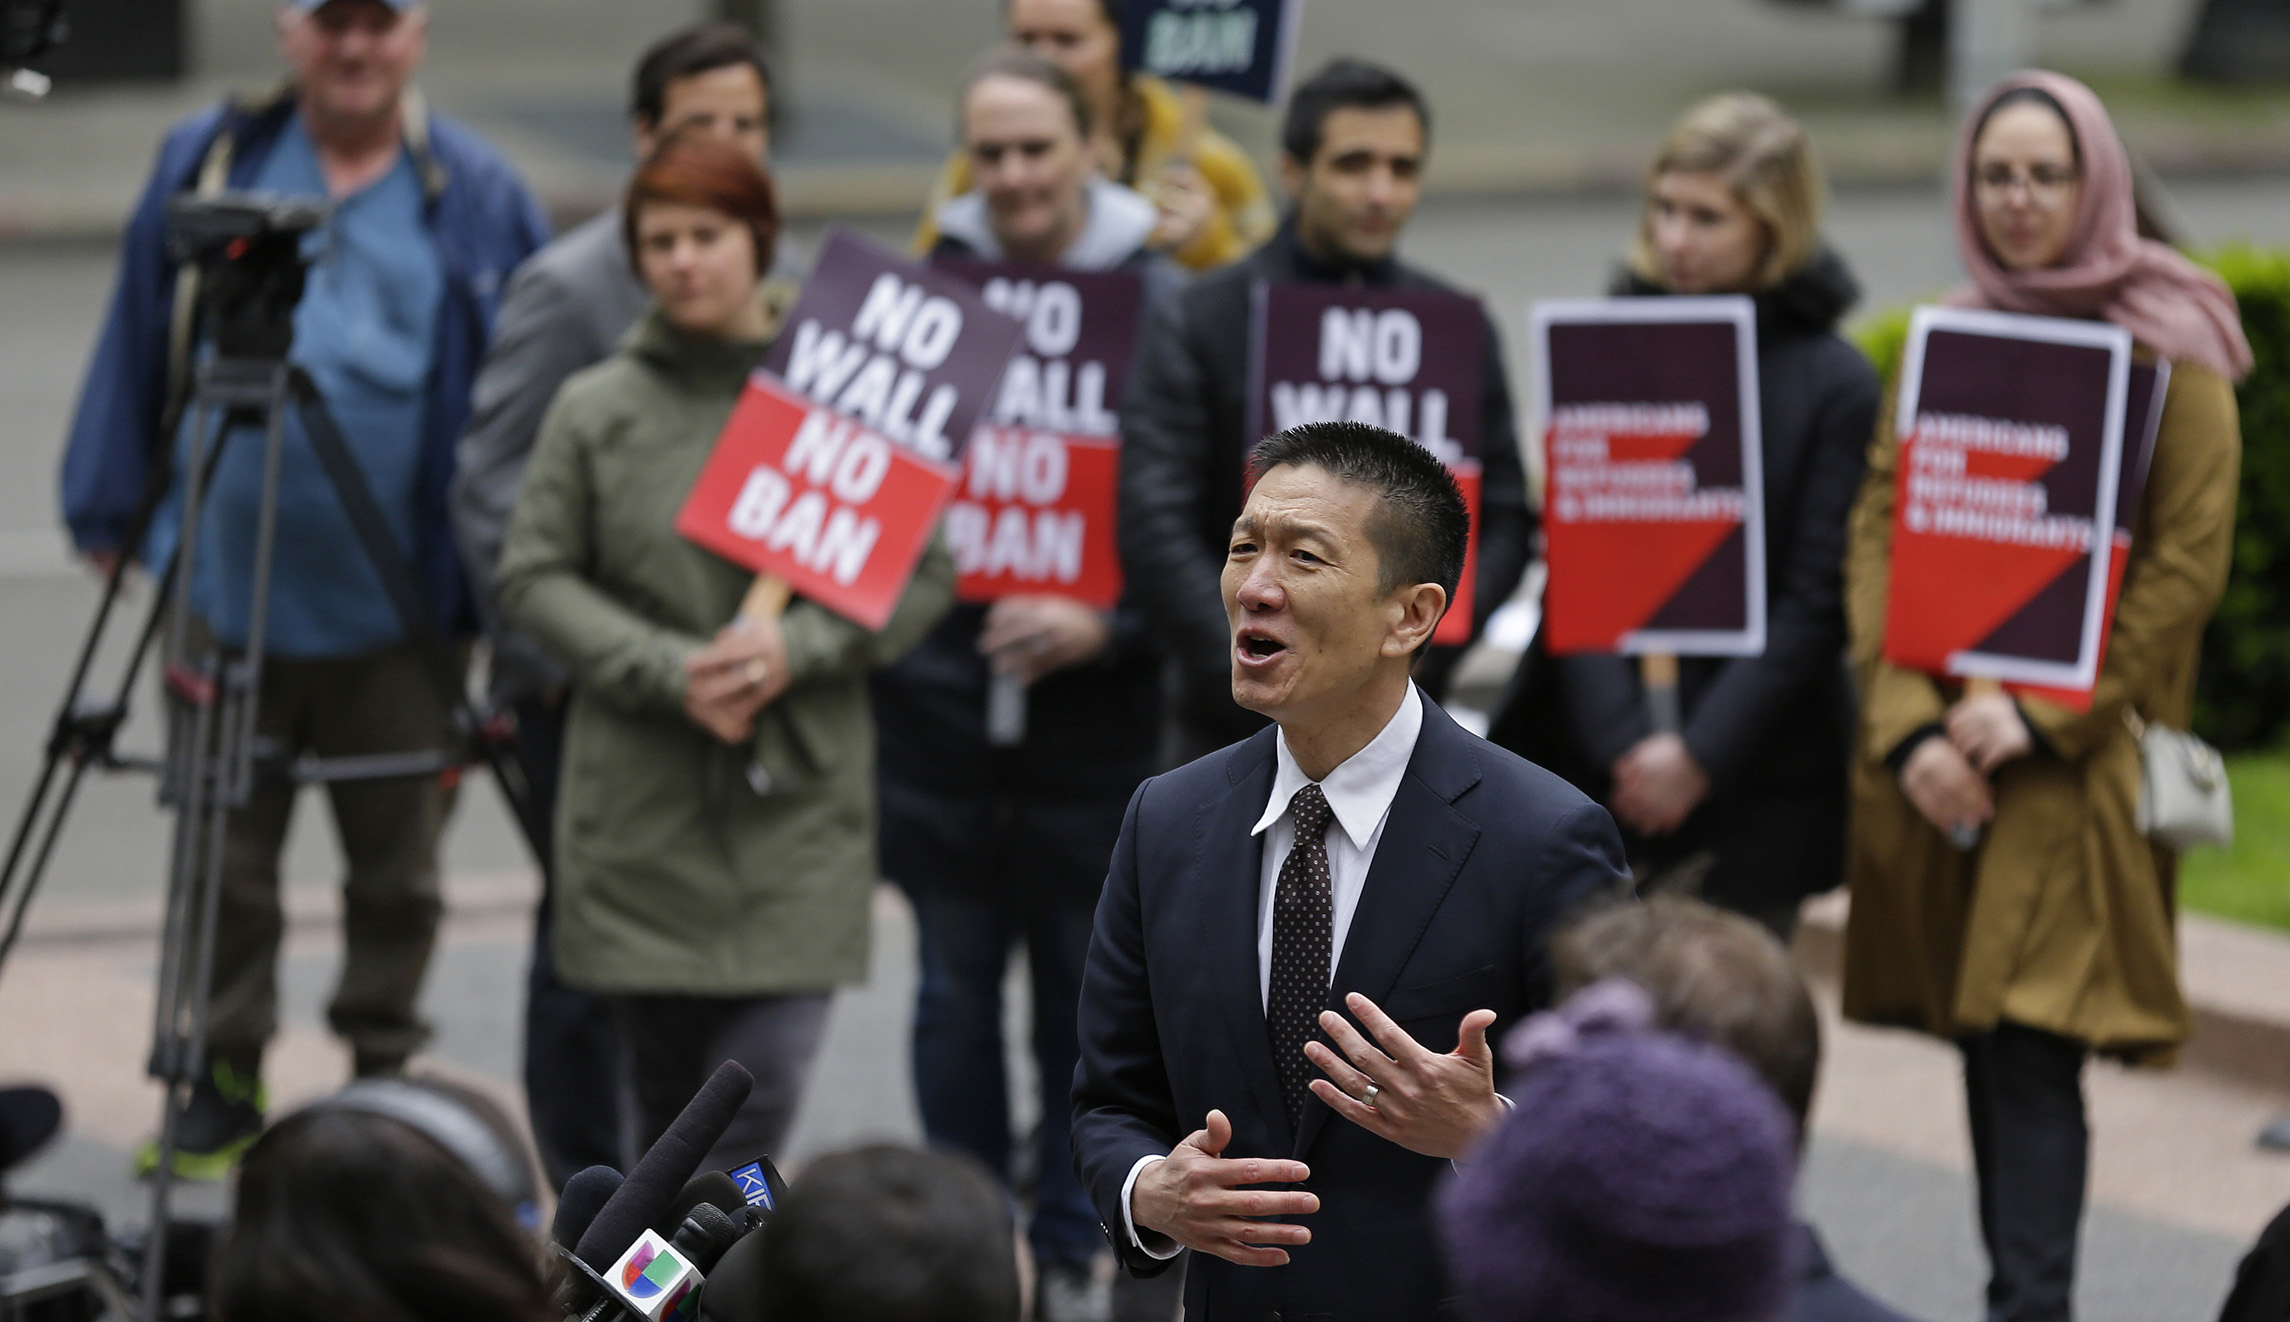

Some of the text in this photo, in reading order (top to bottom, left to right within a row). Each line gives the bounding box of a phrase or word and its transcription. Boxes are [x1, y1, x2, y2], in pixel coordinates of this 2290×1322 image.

[853, 272, 963, 370] NO
[1317, 306, 1423, 385] NO
[785, 317, 958, 462] WALL
[994, 355, 1119, 436] ALL
[782, 408, 893, 505] NO
[967, 424, 1069, 506] NO
[727, 464, 882, 587] BAN
[945, 502, 1085, 582] BAN
[736, 1168, 773, 1211] KIF
